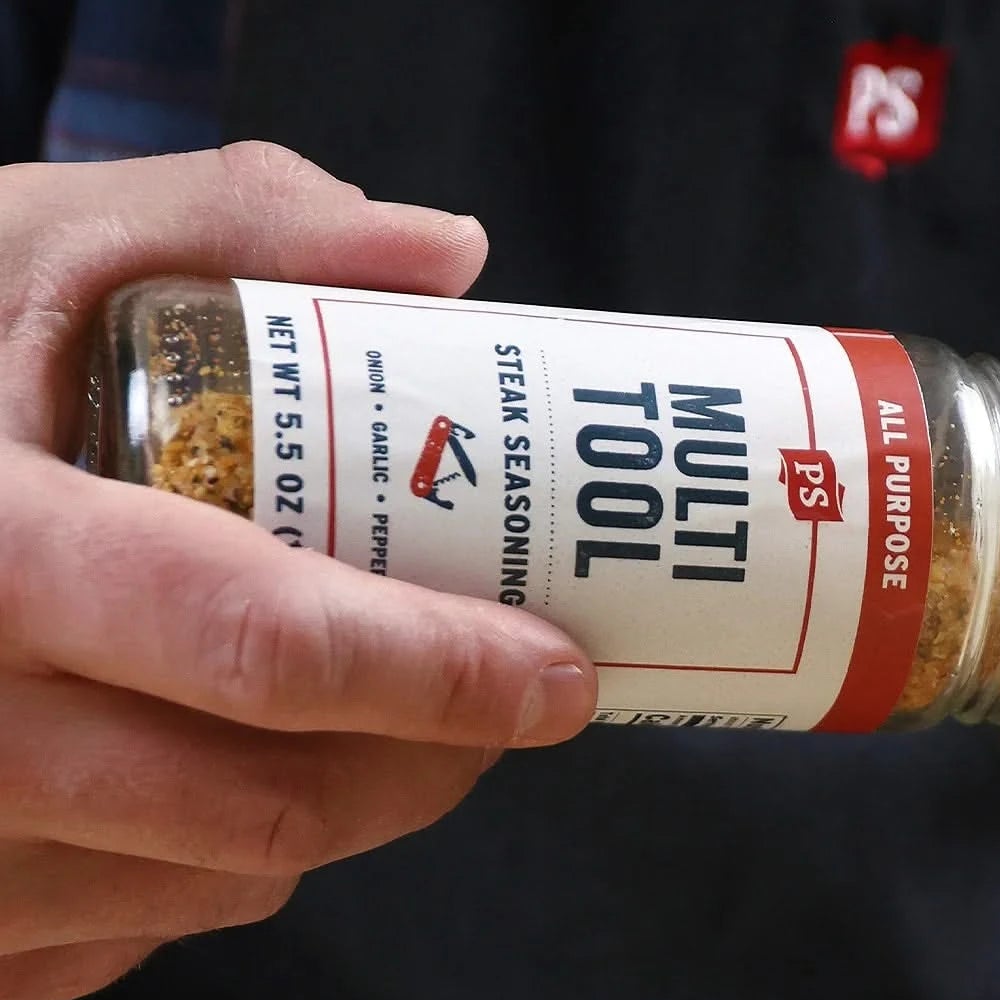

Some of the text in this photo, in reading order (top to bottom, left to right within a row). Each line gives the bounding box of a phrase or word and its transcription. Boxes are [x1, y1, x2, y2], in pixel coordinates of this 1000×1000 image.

[265, 315, 297, 354] NET
[272, 362, 302, 400] WT
[365, 350, 385, 394] ONION
[274, 412, 303, 461] 5.5
[371, 422, 390, 484] GARLIC
[274, 473, 303, 514] OZ
[494, 343, 532, 607] STEAK SEASONING
[573, 382, 663, 578] TOOL
[669, 384, 749, 581] MULTI
[793, 460, 829, 509] PS
[877, 399, 911, 590] ALL PURPOSE
